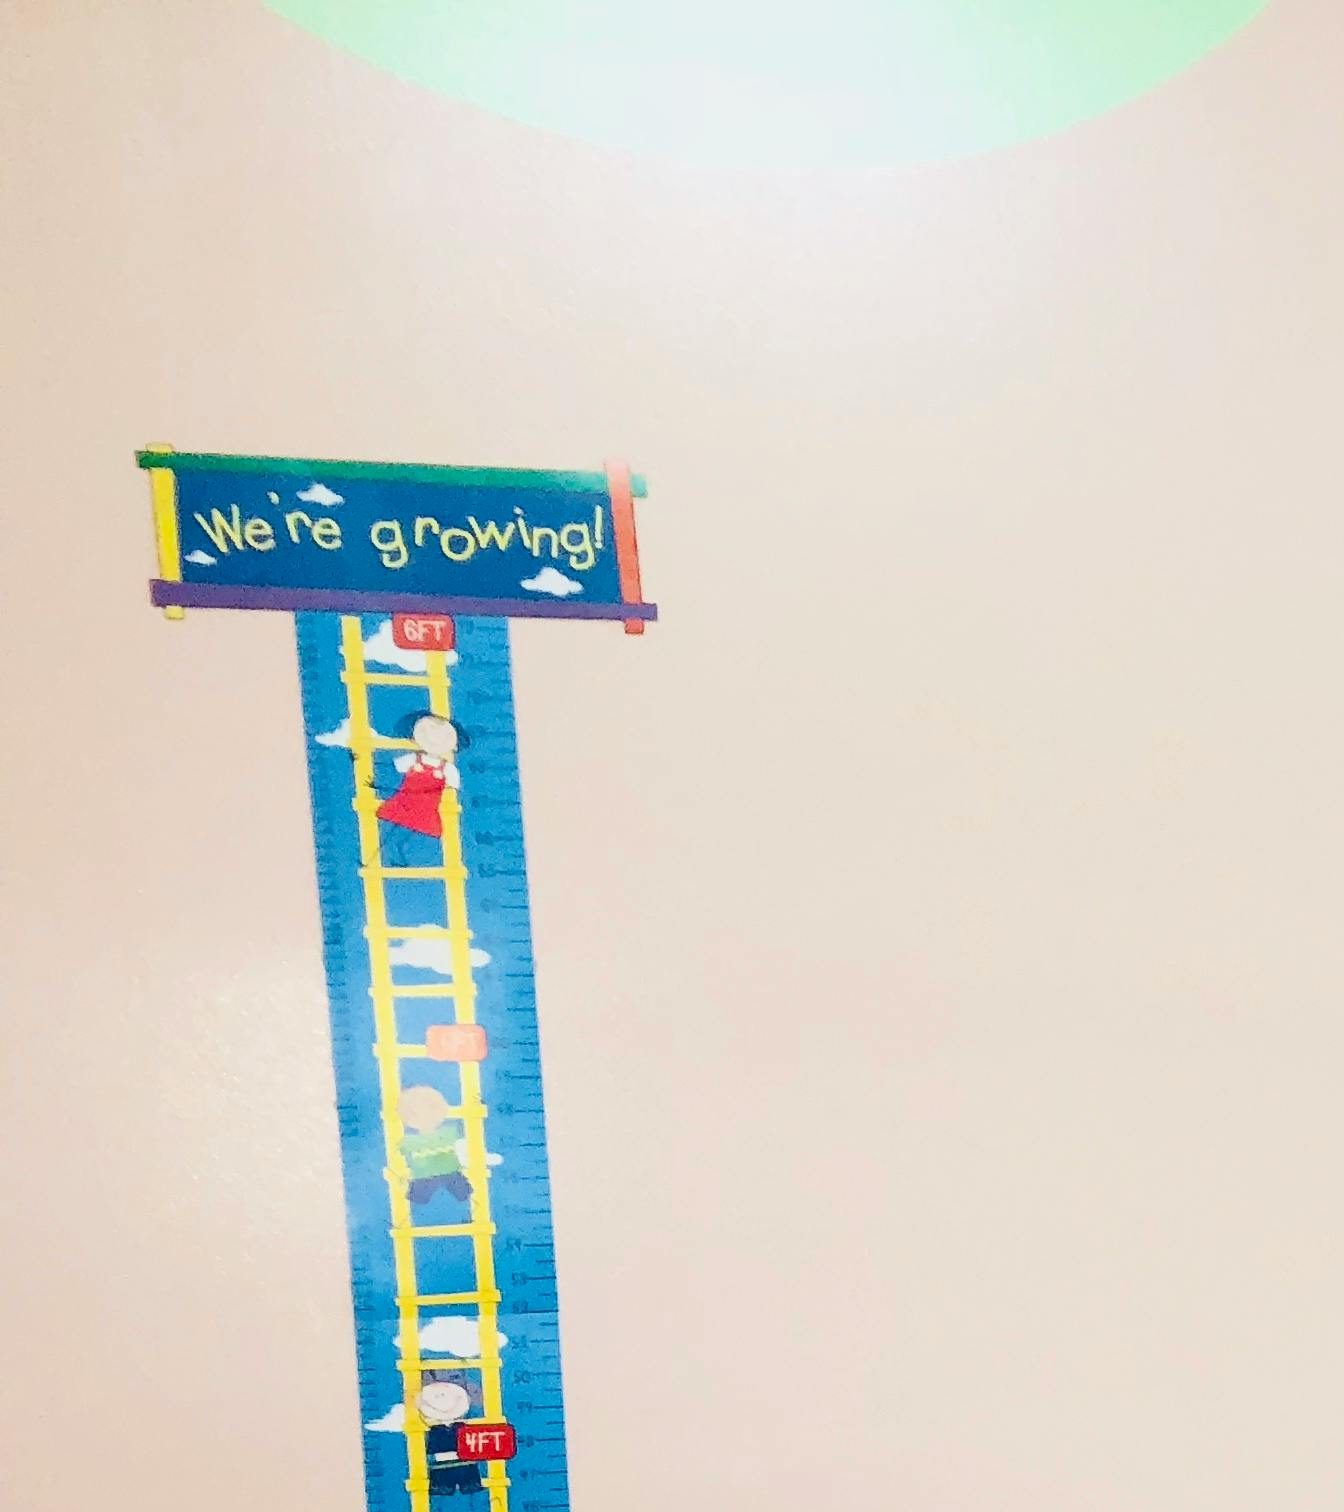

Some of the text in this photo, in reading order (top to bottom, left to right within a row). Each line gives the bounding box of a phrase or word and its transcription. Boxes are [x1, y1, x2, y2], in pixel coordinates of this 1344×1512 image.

[194, 490, 604, 570] We're growing!
[403, 619, 445, 642] 6FT
[465, 1431, 505, 1453] 4FT
